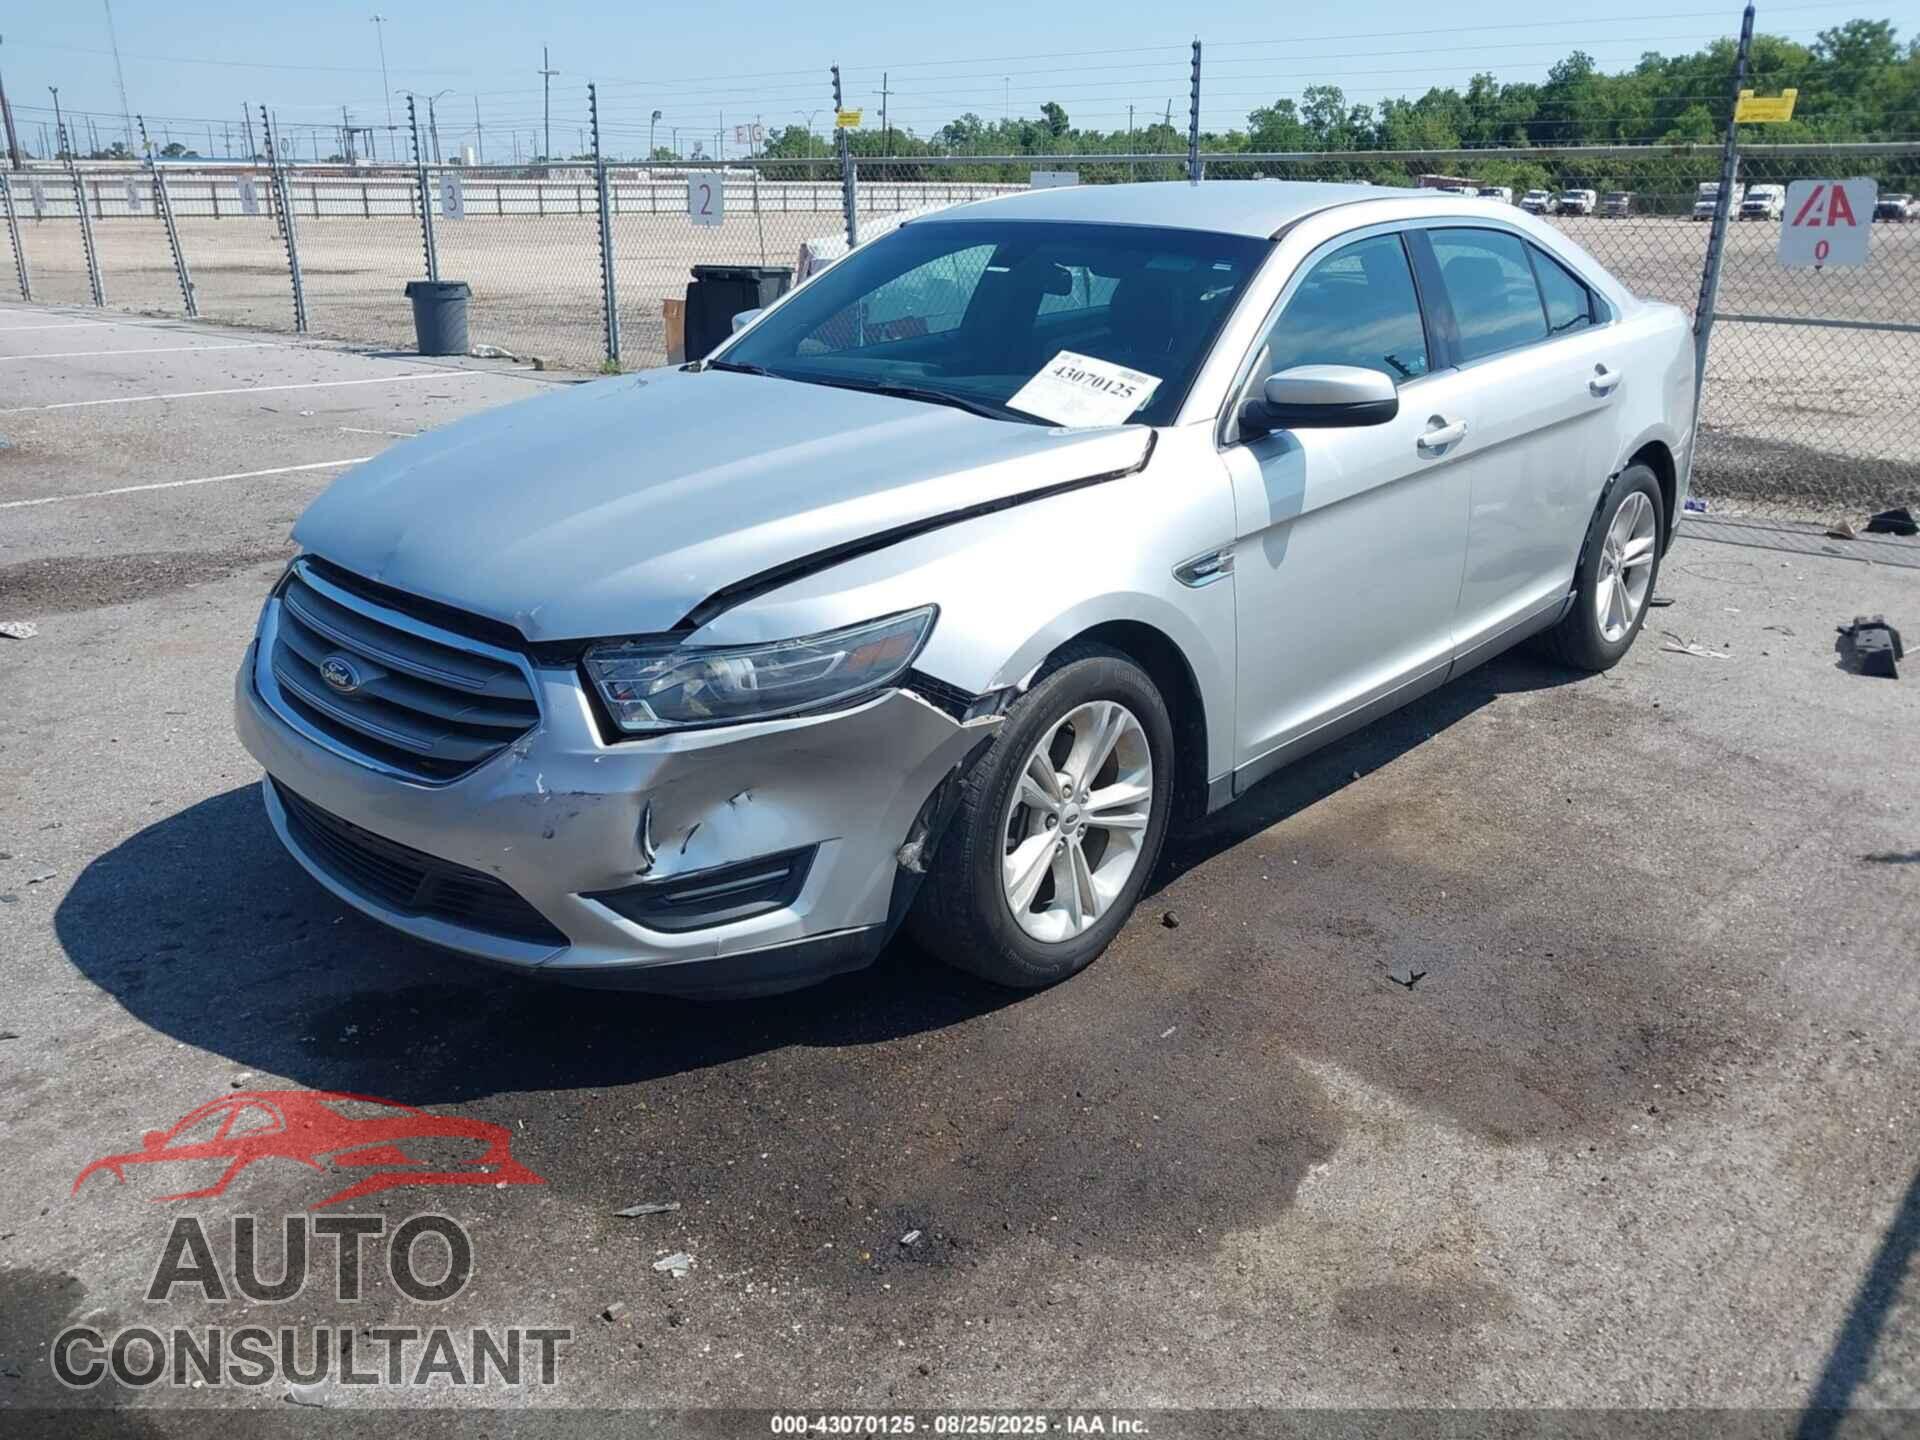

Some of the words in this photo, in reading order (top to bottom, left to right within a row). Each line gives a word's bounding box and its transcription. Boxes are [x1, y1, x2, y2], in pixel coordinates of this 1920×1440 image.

[447, 184, 457, 211] 3
[699, 183, 712, 215] 2
[1053, 365, 1137, 399] 43070125
